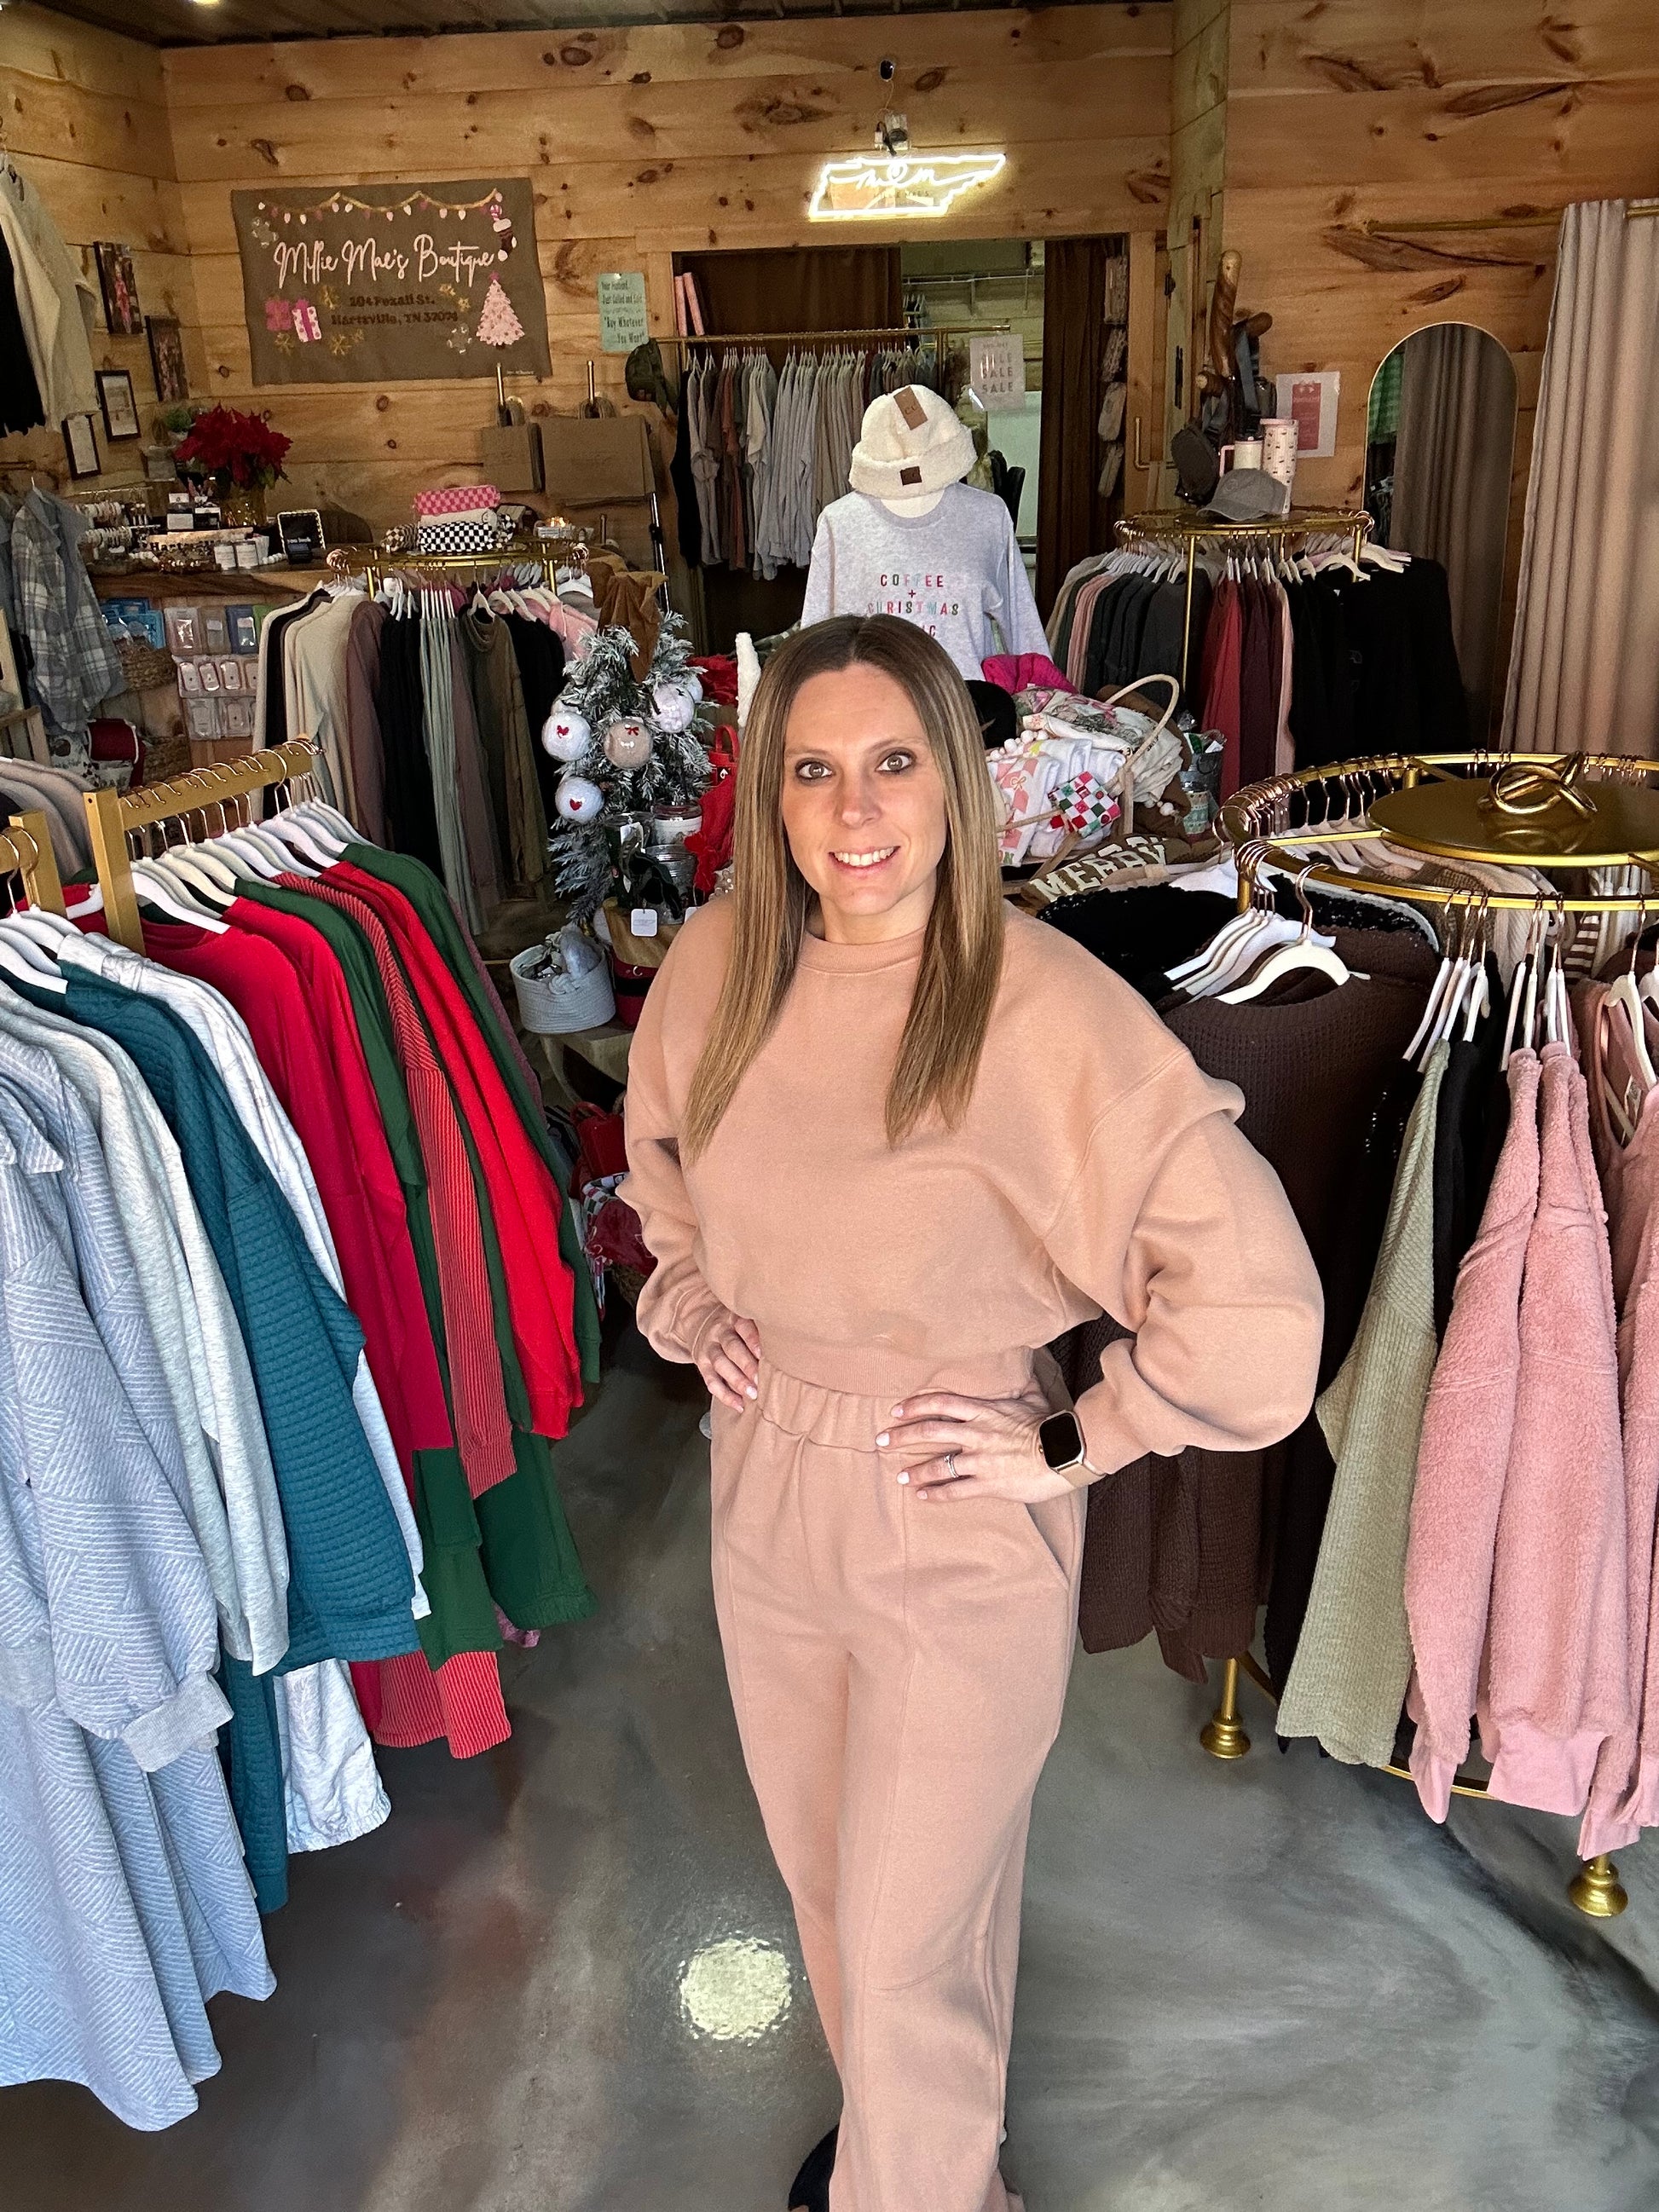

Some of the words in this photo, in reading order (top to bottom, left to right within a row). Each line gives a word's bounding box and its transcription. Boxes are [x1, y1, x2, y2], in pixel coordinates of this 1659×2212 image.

[273, 240, 338, 289] Millie
[342, 238, 408, 286] Mae's
[413, 234, 494, 287] Boutique
[404, 312, 421, 323] TN
[983, 367, 1013, 378] SALE
[982, 382, 1014, 393] SALE
[881, 575, 944, 587] COFFEE
[868, 601, 959, 615] CHRISTMAS
